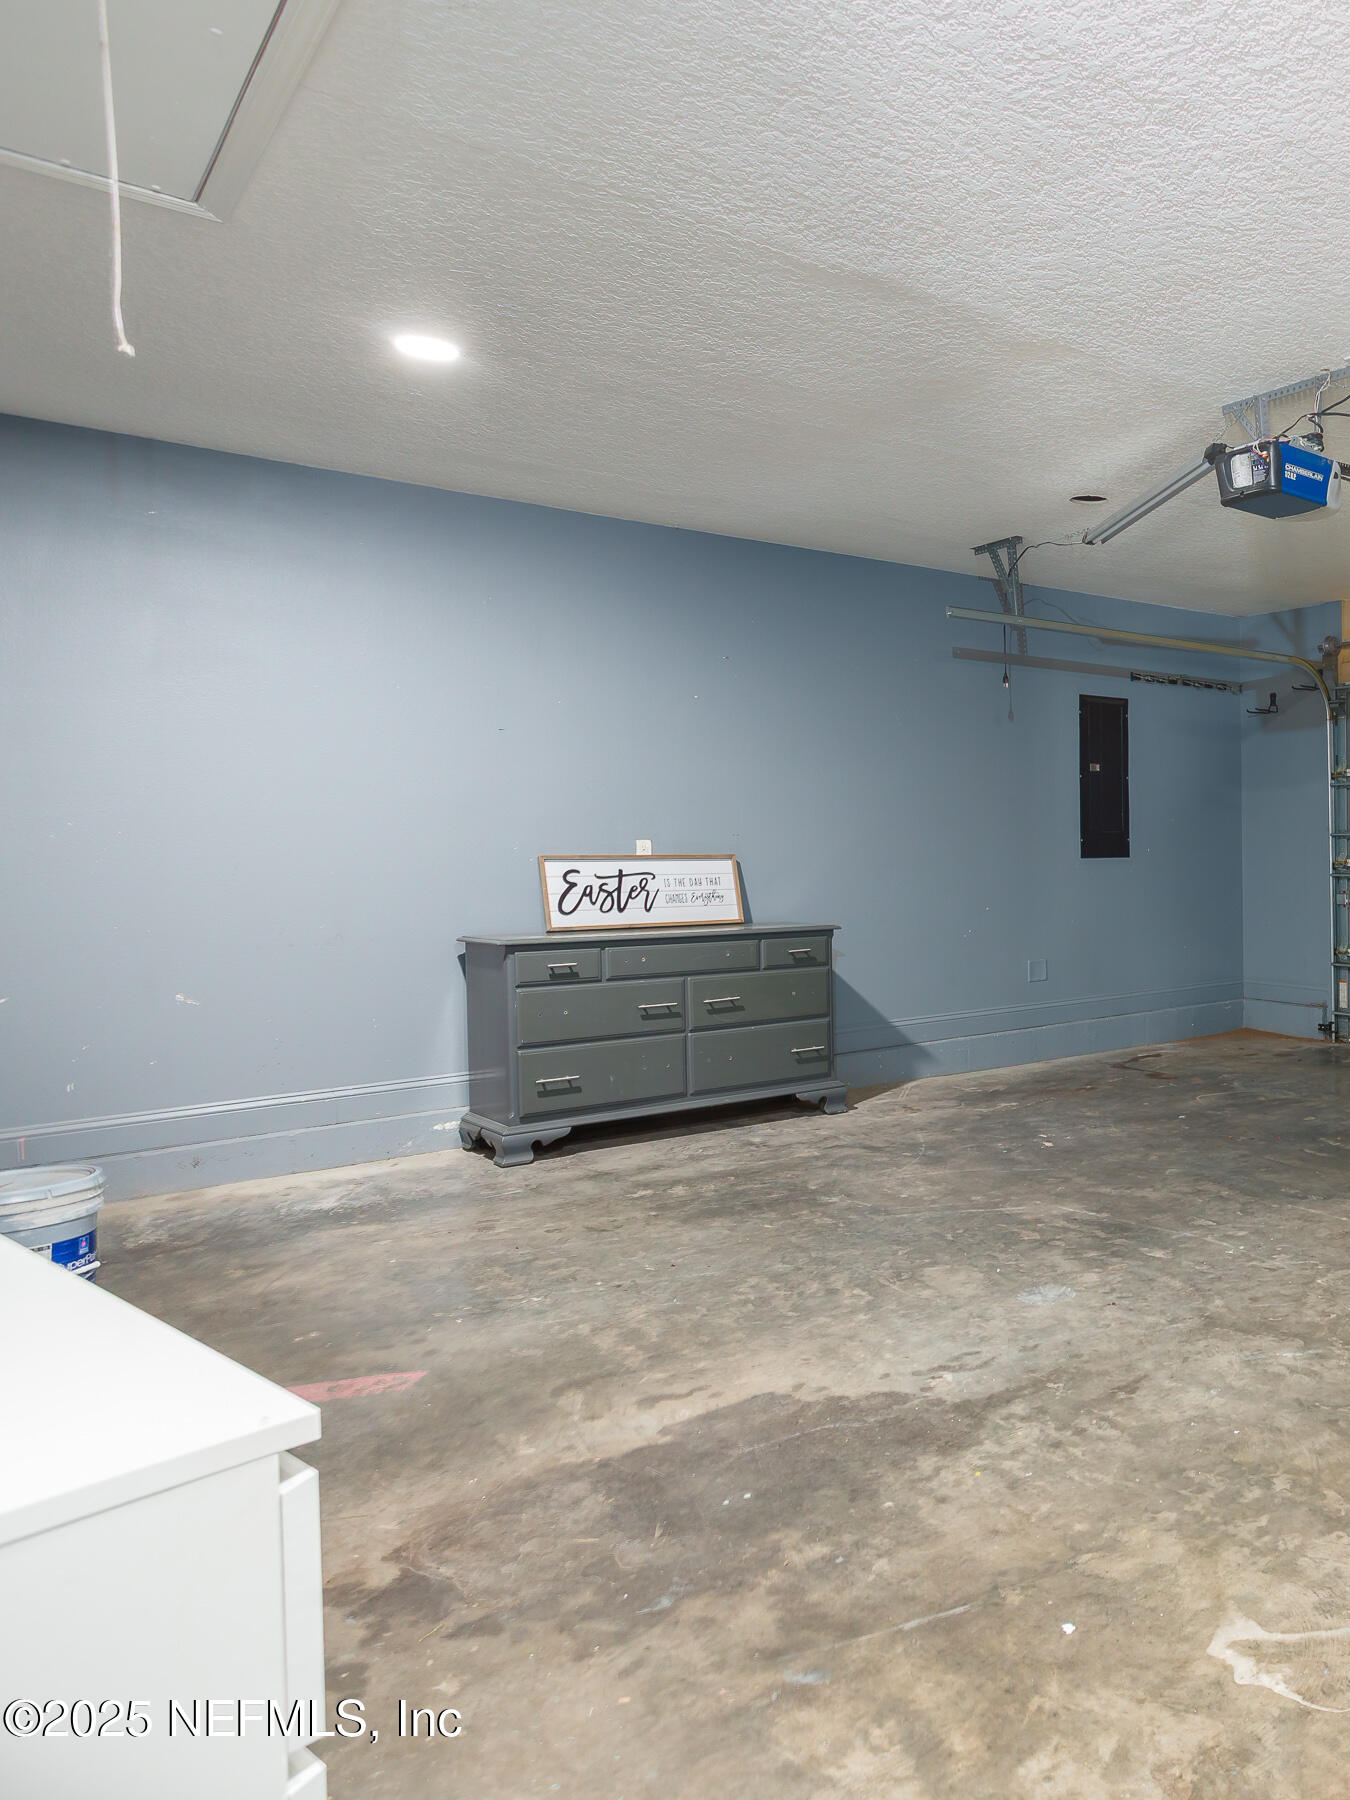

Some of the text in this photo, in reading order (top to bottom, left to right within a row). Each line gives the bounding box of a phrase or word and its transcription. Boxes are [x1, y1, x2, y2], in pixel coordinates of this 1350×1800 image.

[664, 878, 671, 888] IS
[674, 877, 686, 887] THE
[706, 876, 721, 886] THAT
[557, 868, 660, 916] Easter
[665, 893, 688, 904] CHANGES
